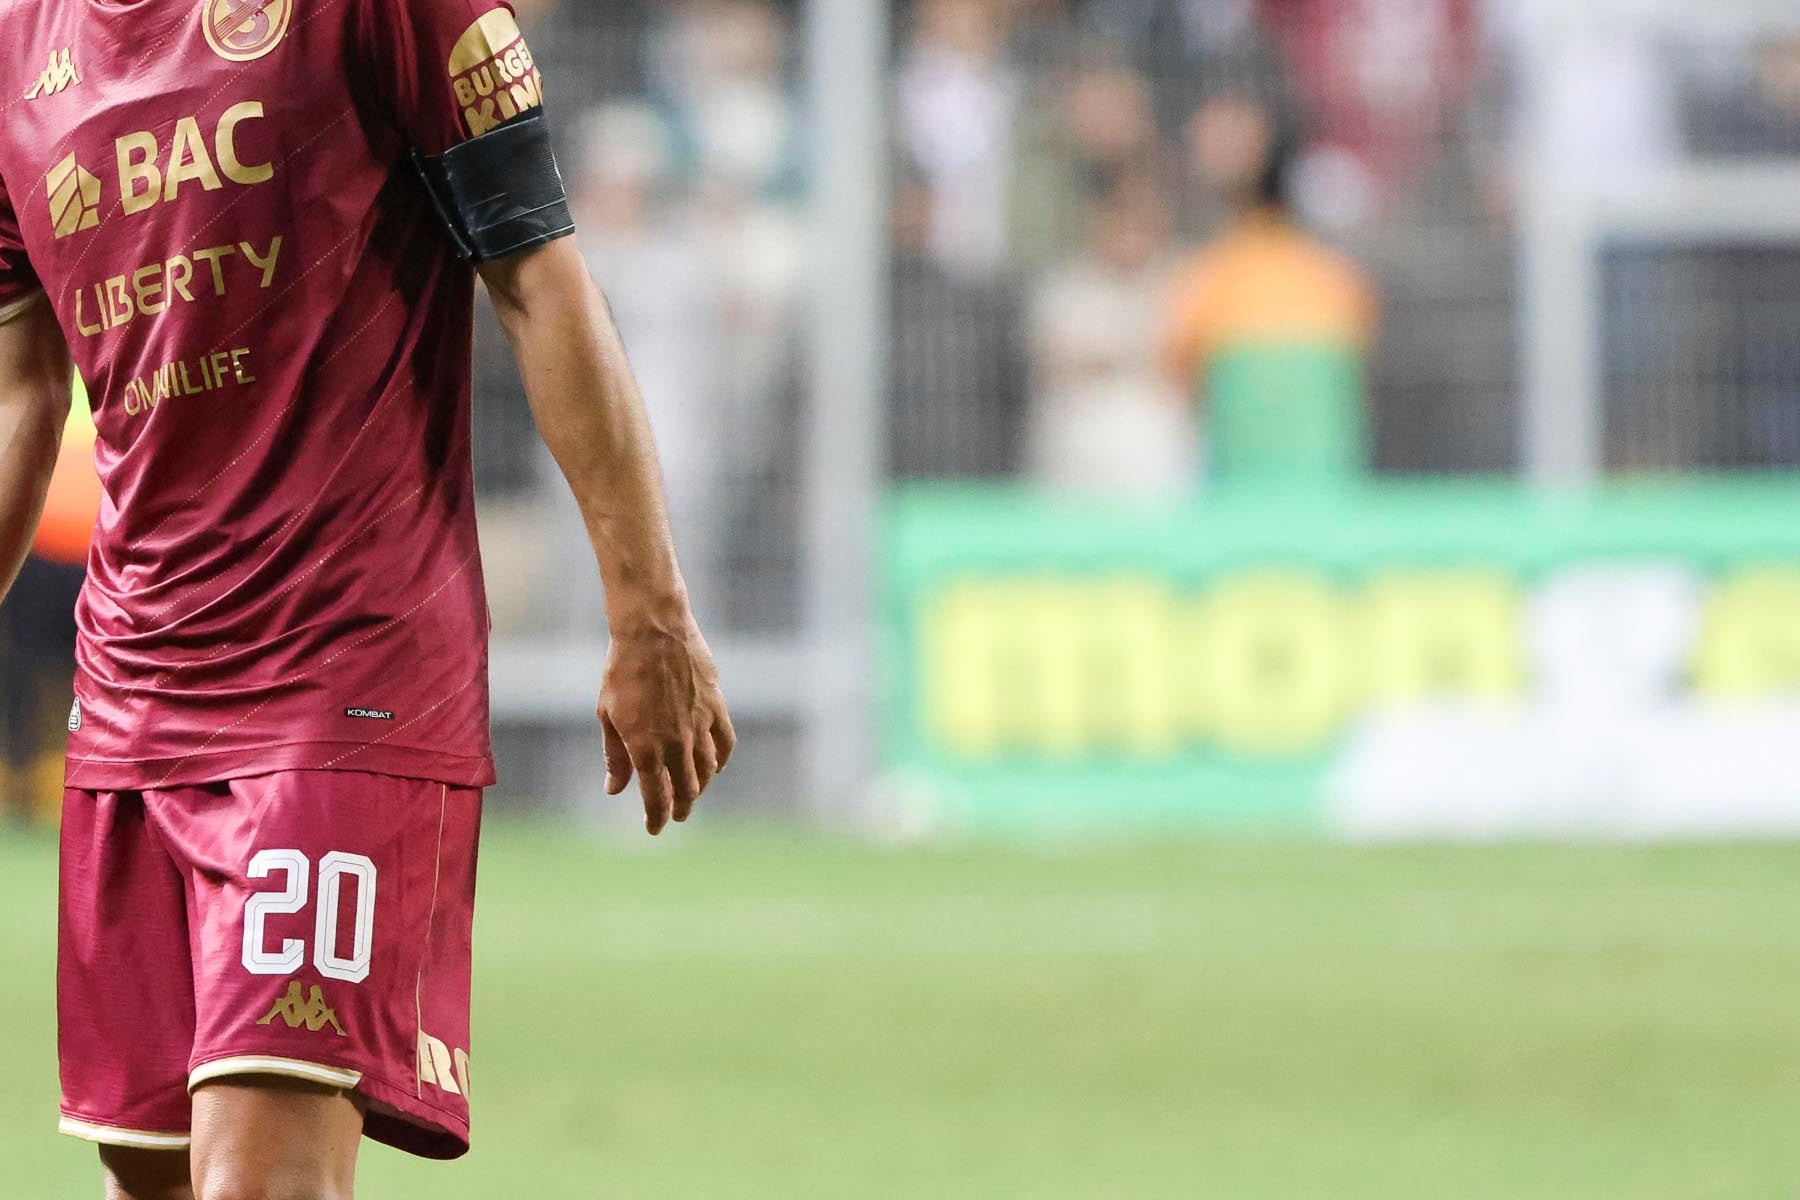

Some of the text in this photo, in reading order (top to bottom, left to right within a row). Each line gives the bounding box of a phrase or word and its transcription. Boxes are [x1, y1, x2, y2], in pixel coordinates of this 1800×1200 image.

[453, 37, 536, 107] BURGE
[464, 65, 544, 138] KIN
[115, 100, 274, 217] BAC
[75, 235, 283, 338] LIBERTY
[347, 708, 392, 719] KOMBAT
[241, 848, 378, 984] 20
